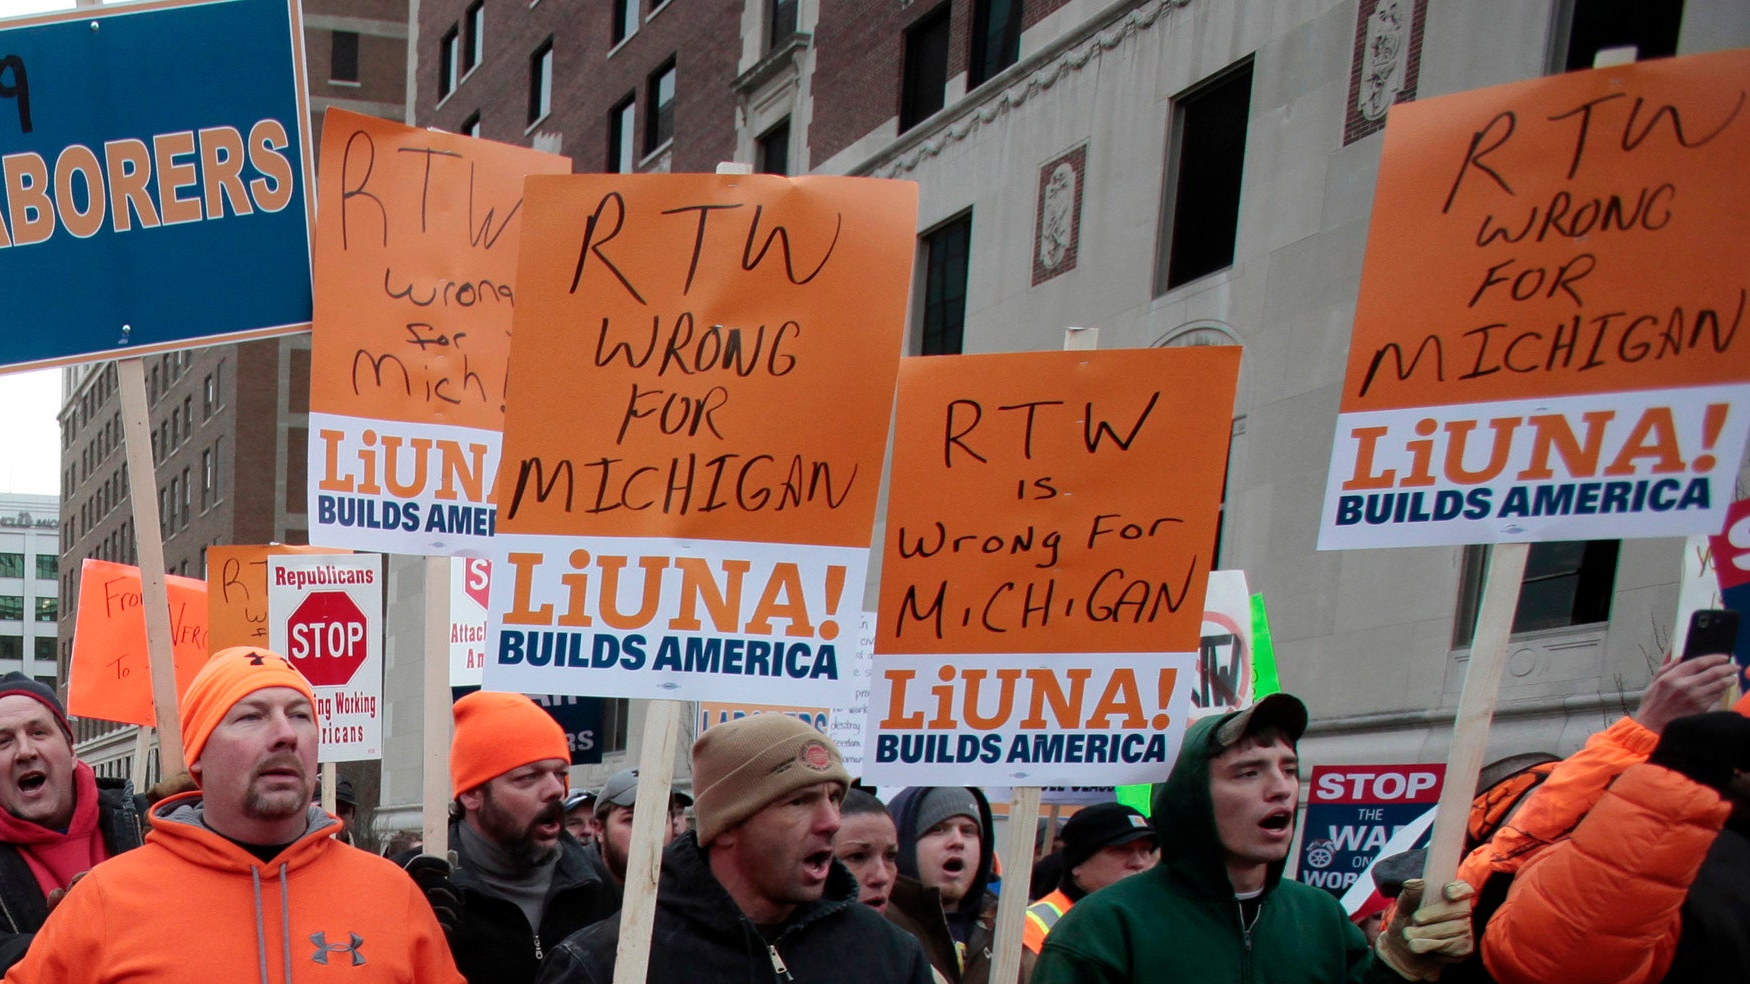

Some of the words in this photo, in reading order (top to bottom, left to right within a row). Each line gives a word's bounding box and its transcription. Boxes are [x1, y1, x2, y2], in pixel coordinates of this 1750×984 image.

[1475, 183, 1675, 247] WRONG
[569, 192, 841, 305] RTW
[1469, 254, 1596, 307] FOR
[594, 311, 799, 377] WRONG
[1359, 289, 1748, 397] MICHIGAN
[616, 384, 728, 445] FOR
[318, 428, 500, 503] LiUN
[1342, 402, 1730, 491] LiUNA!
[318, 494, 420, 530] BUILDS
[507, 453, 859, 520] MICHIGAN
[1335, 487, 1493, 526] BUILDS
[1497, 477, 1711, 518] AMERICA
[275, 566, 374, 589] Republicans
[502, 548, 847, 640] LiUNA!
[292, 621, 363, 659] STOP
[498, 630, 647, 670] BUILDS
[652, 636, 838, 681] AMERICA
[335, 692, 376, 718] Working
[880, 664, 1178, 730] LiUNA!
[875, 733, 1001, 764] BUILDS
[1005, 733, 1167, 764] AMERICA
[1316, 772, 1437, 800] STOP
[1358, 808, 1384, 820] THE
